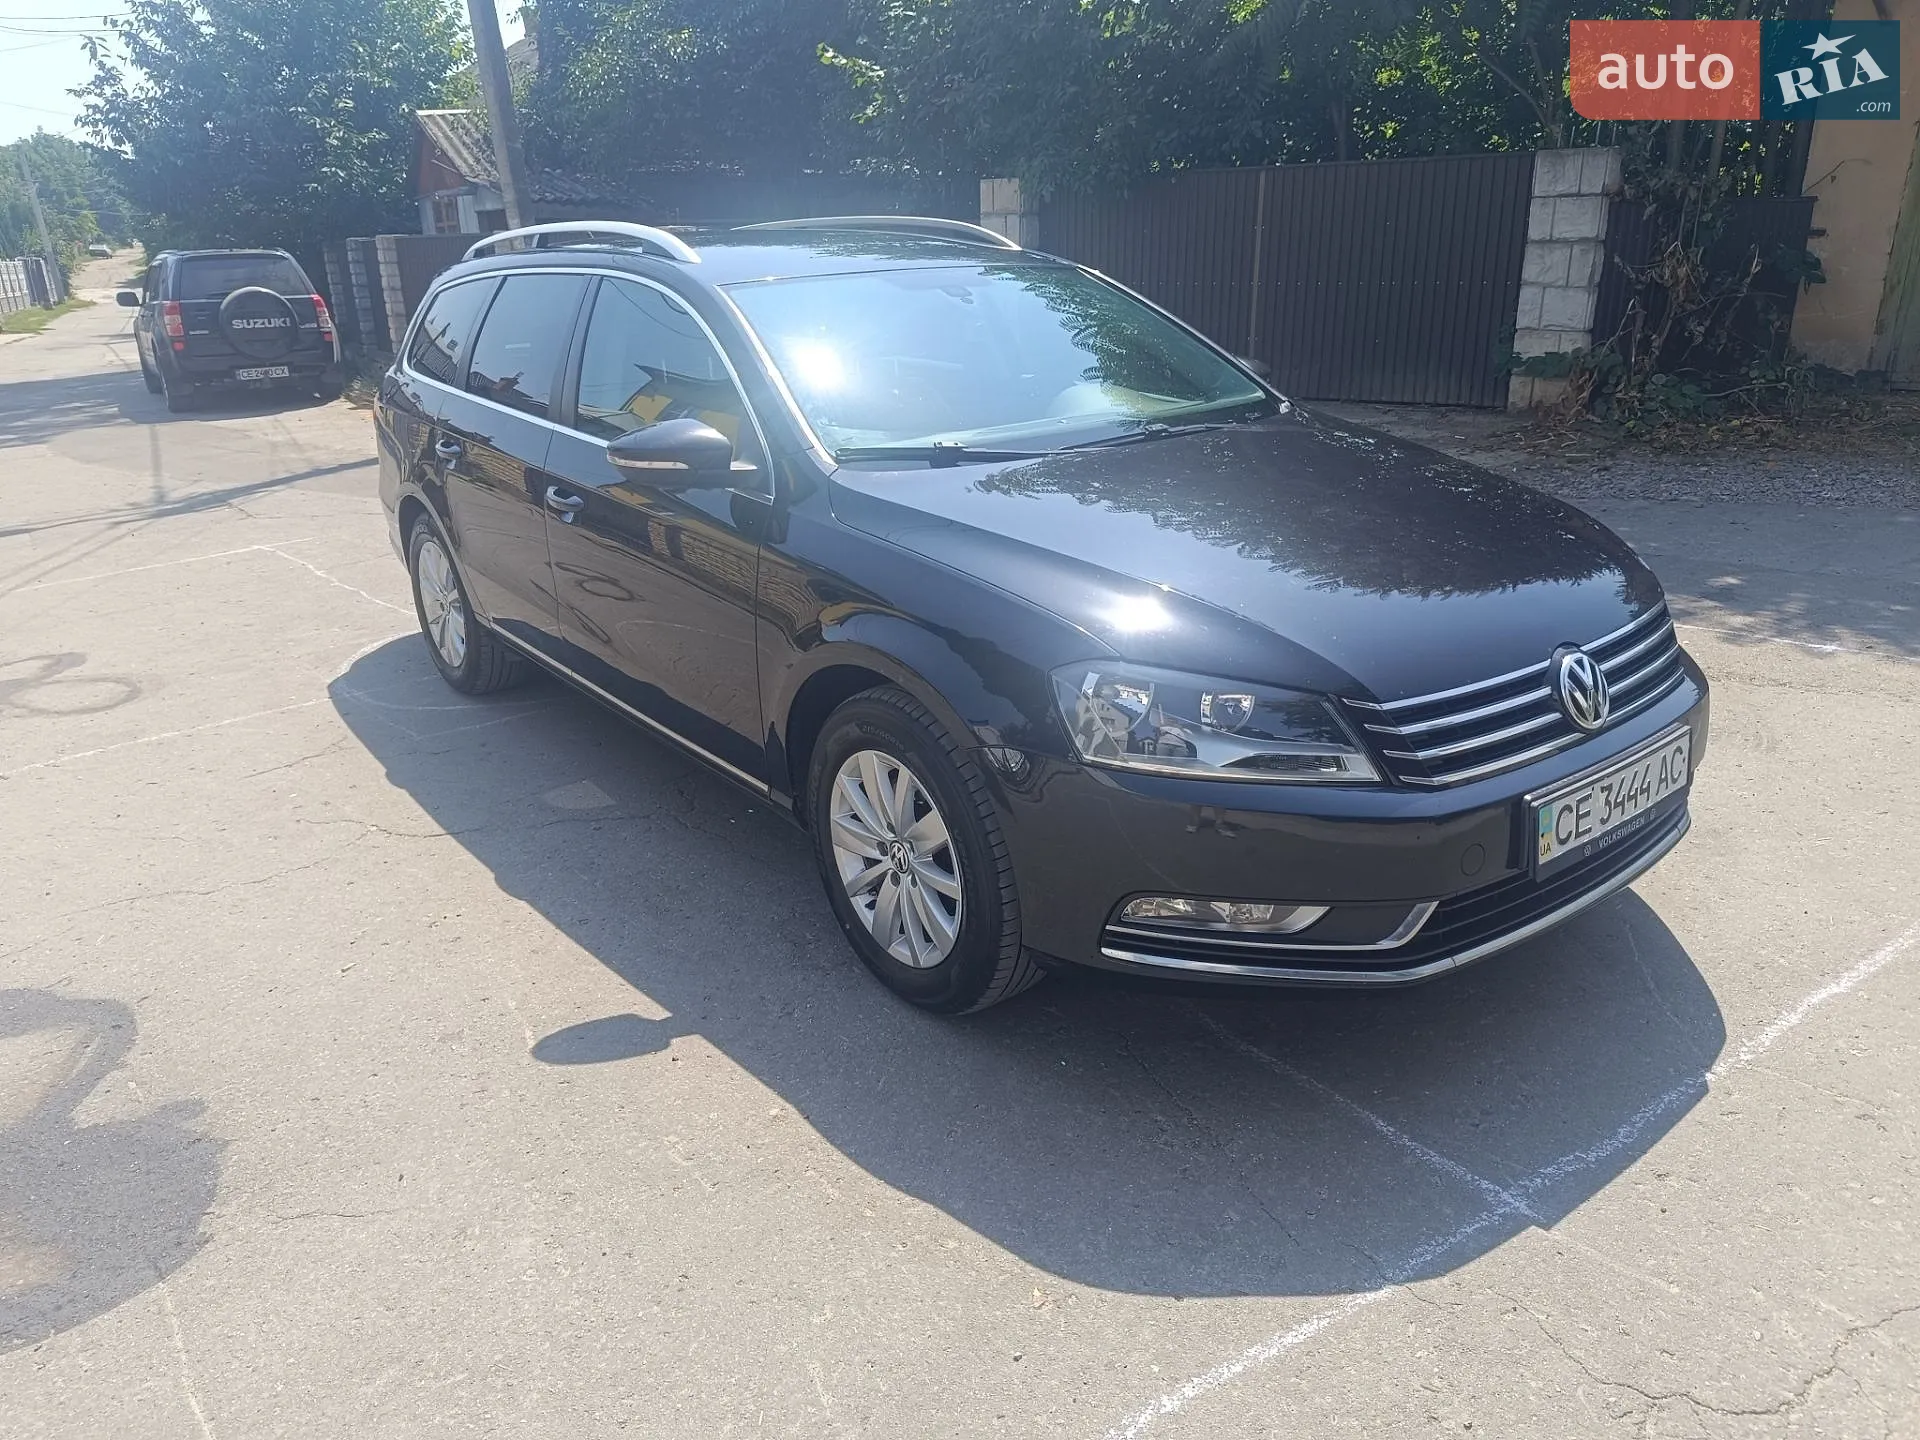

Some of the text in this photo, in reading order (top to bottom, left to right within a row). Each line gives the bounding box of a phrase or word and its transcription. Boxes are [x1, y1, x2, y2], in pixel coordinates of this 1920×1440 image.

[232, 318, 290, 329] SUZUKI
[242, 370, 254, 379] CE
[1555, 745, 1684, 845] CE 3444 AC
[1597, 815, 1646, 848] VOLKSWAGEN
[1540, 841, 1551, 857] UA
